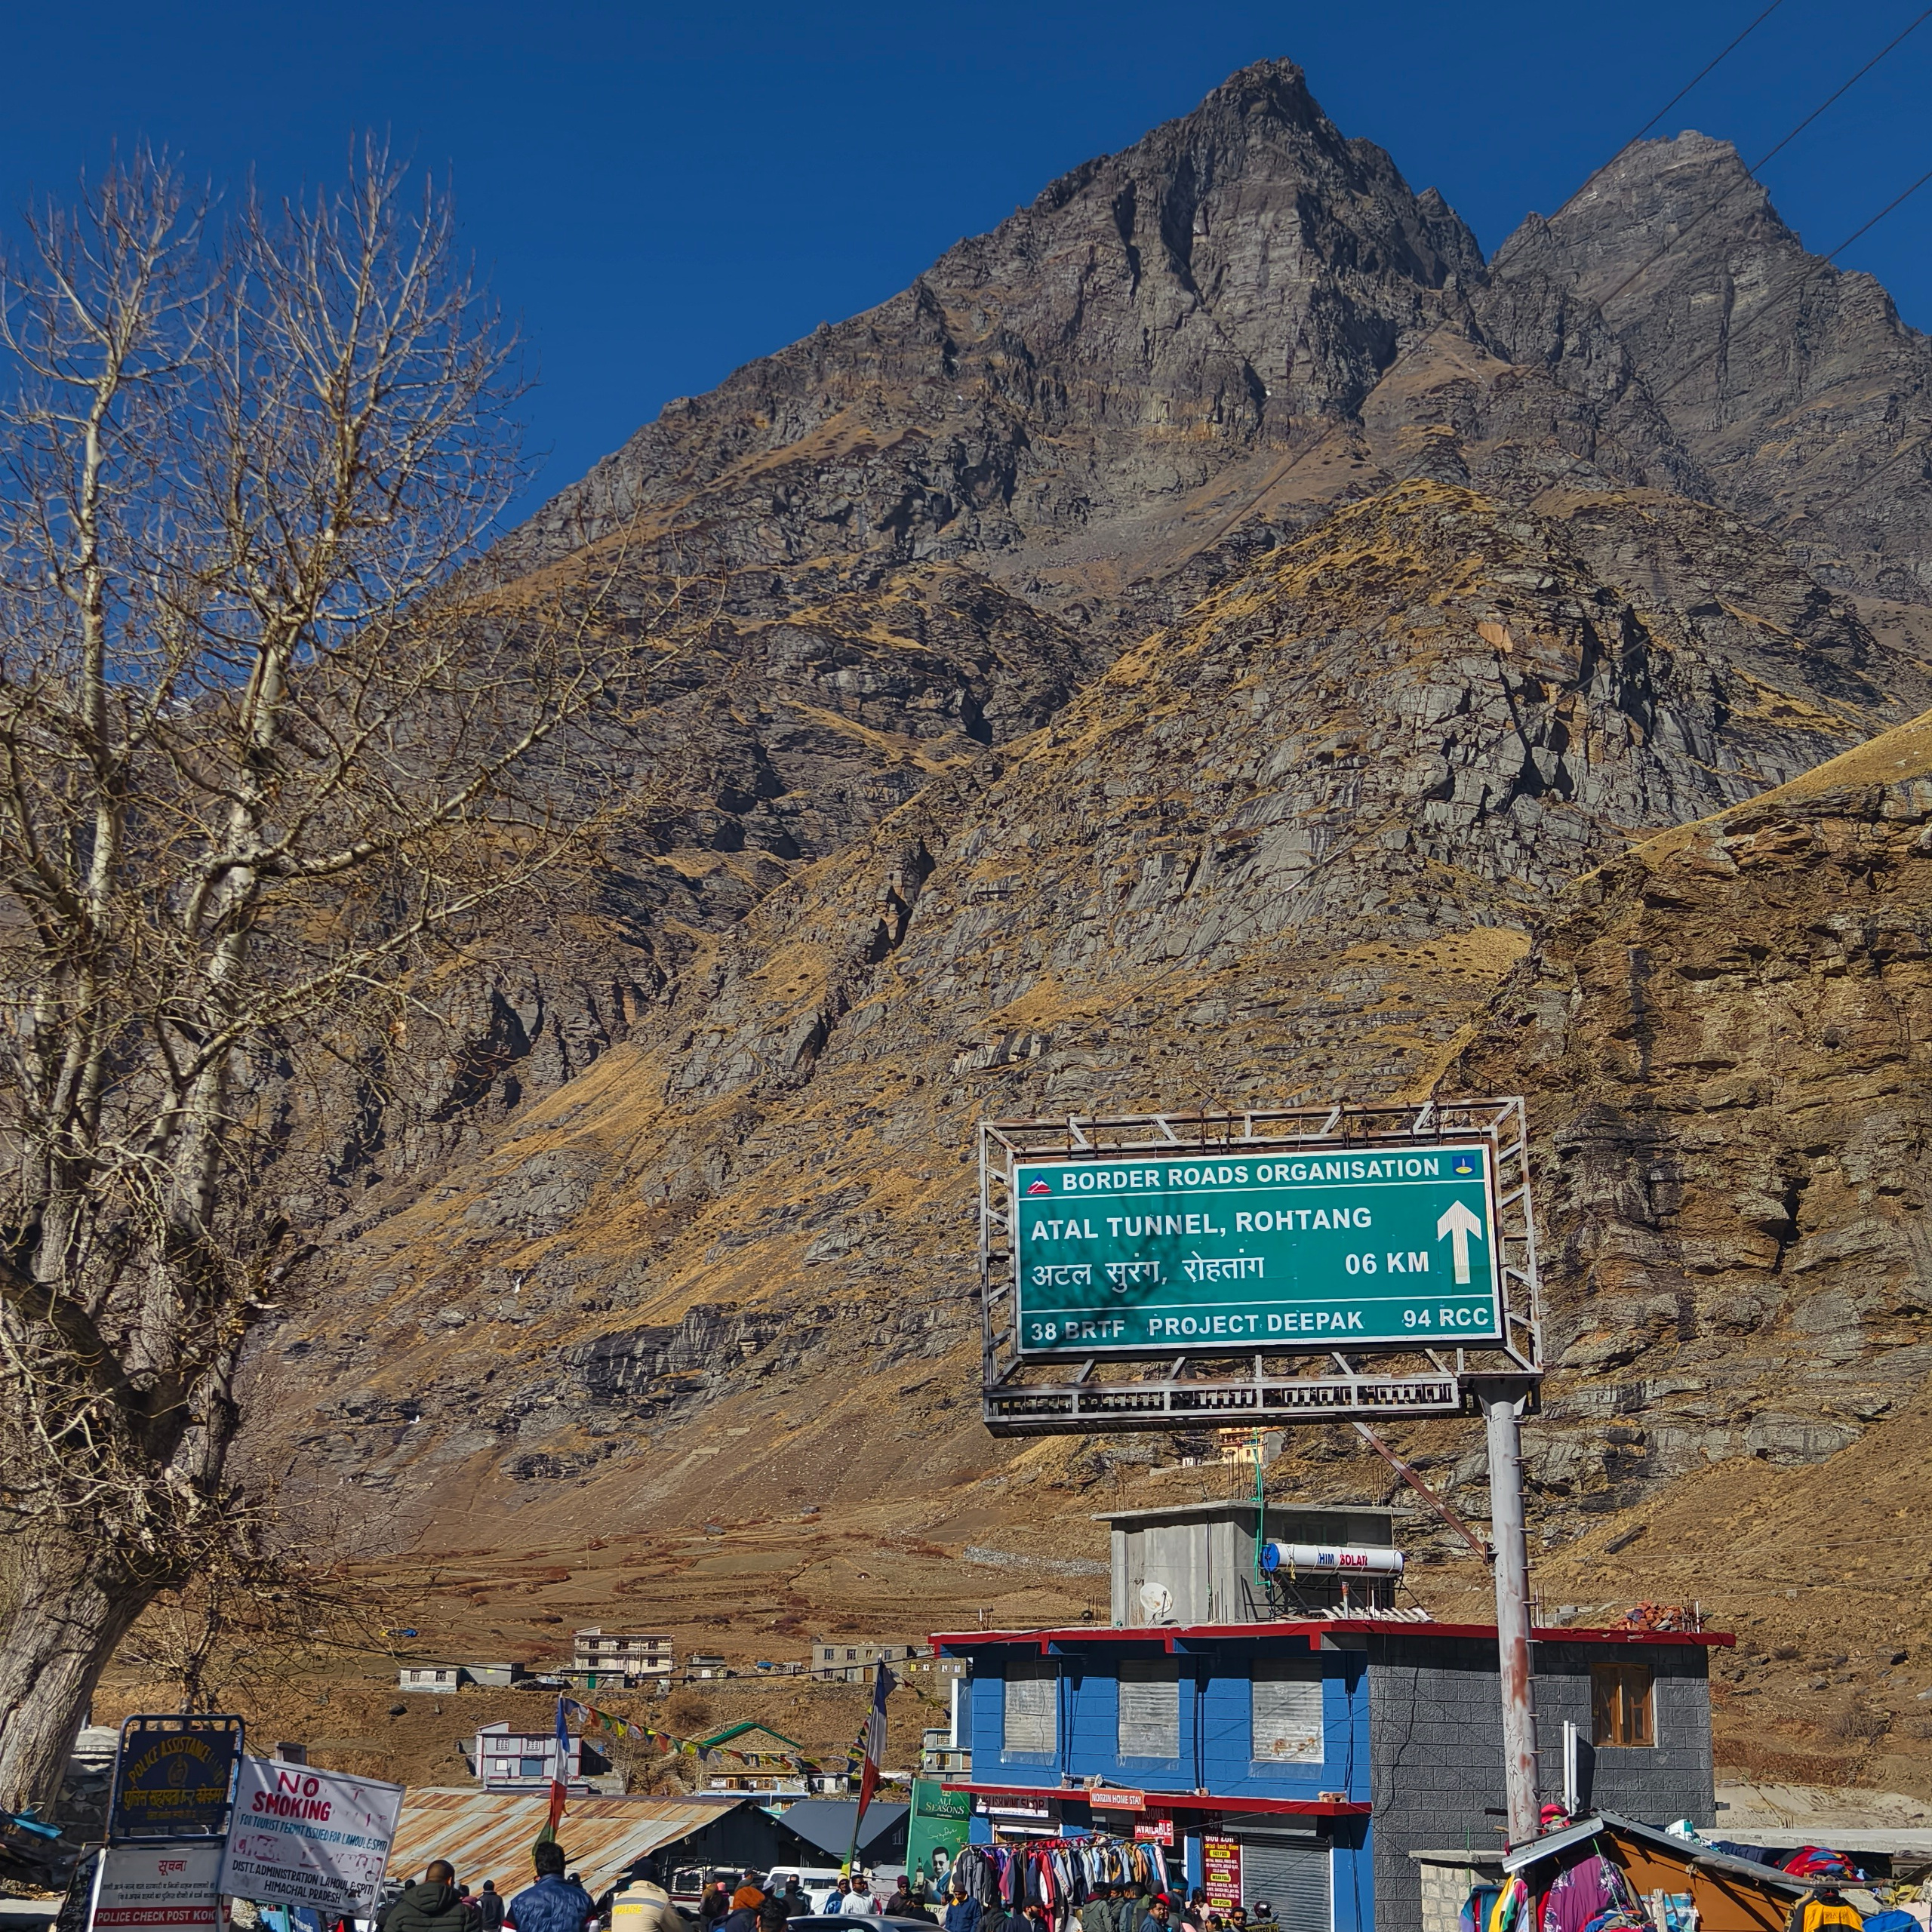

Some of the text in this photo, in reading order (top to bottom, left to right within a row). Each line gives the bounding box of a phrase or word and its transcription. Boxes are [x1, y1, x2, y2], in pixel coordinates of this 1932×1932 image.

[1063, 1158, 1440, 1192] BORDER ROADS ORGANISATION
[1031, 1208, 1372, 1241] ATAL TUNNEL, ROHTANG
[1032, 1249, 1265, 1293] अटल सुरंग, रोहतांग
[1346, 1252, 1429, 1275] 06 KM
[1031, 1307, 1489, 1340] 38 BRTF PROJECT DEEPAK 94 RCC
[1318, 1552, 1367, 1566] HIM SOLAR
[128, 1746, 159, 1783] POLICE
[277, 1771, 320, 1797] NO
[252, 1791, 332, 1822] SMOKING
[926, 1802, 965, 1814] SEASONS
[938, 1798, 953, 1806] ALL
[1112, 1795, 1128, 1804] HOME
[1130, 1796, 1142, 1805] STAY
[239, 1814, 253, 1826] FOR
[253, 1816, 281, 1832] TOURIST
[305, 1825, 330, 1841] ISSUED
[330, 1829, 342, 1844] FOR
[1137, 1821, 1171, 1836] AVAILABLE
[158, 1860, 188, 1876] सूचना
[264, 1879, 342, 1904] HIMACHAL PRADESH
[319, 1875, 349, 1895] LAHOUL
[97, 1909, 229, 1922] POLICE CHECK POST KOKR
